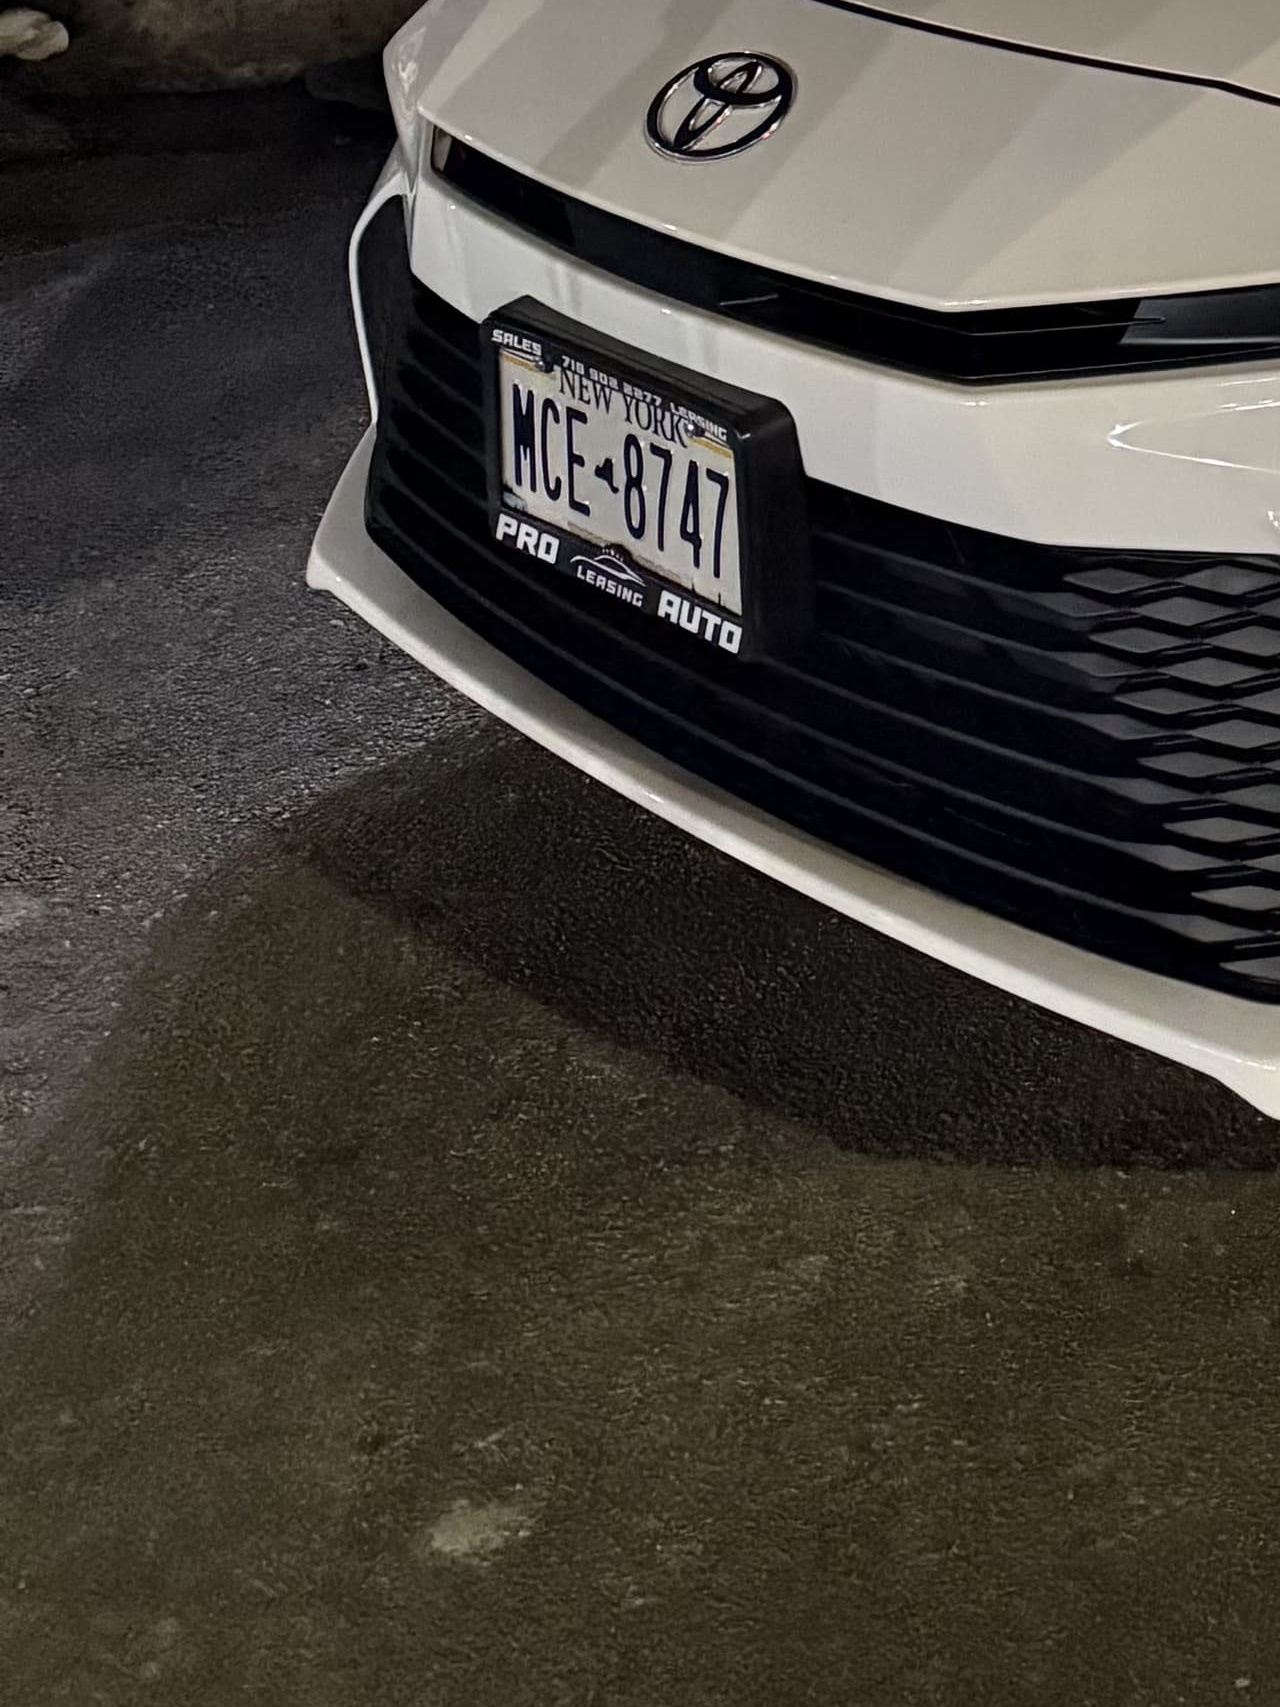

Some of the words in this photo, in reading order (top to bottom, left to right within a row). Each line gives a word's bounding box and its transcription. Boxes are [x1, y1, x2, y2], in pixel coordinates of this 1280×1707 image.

[491, 329, 542, 356] SALES
[561, 355, 585, 375] 718
[589, 368, 620, 391] 902
[670, 402, 728, 442] LEASING
[556, 367, 615, 414] NEW
[622, 393, 688, 448] YORK
[511, 383, 591, 517] MCE
[622, 433, 730, 579] 8747
[495, 513, 560, 564] PRO
[576, 564, 644, 608] LEASING
[657, 589, 743, 655] AUTO
